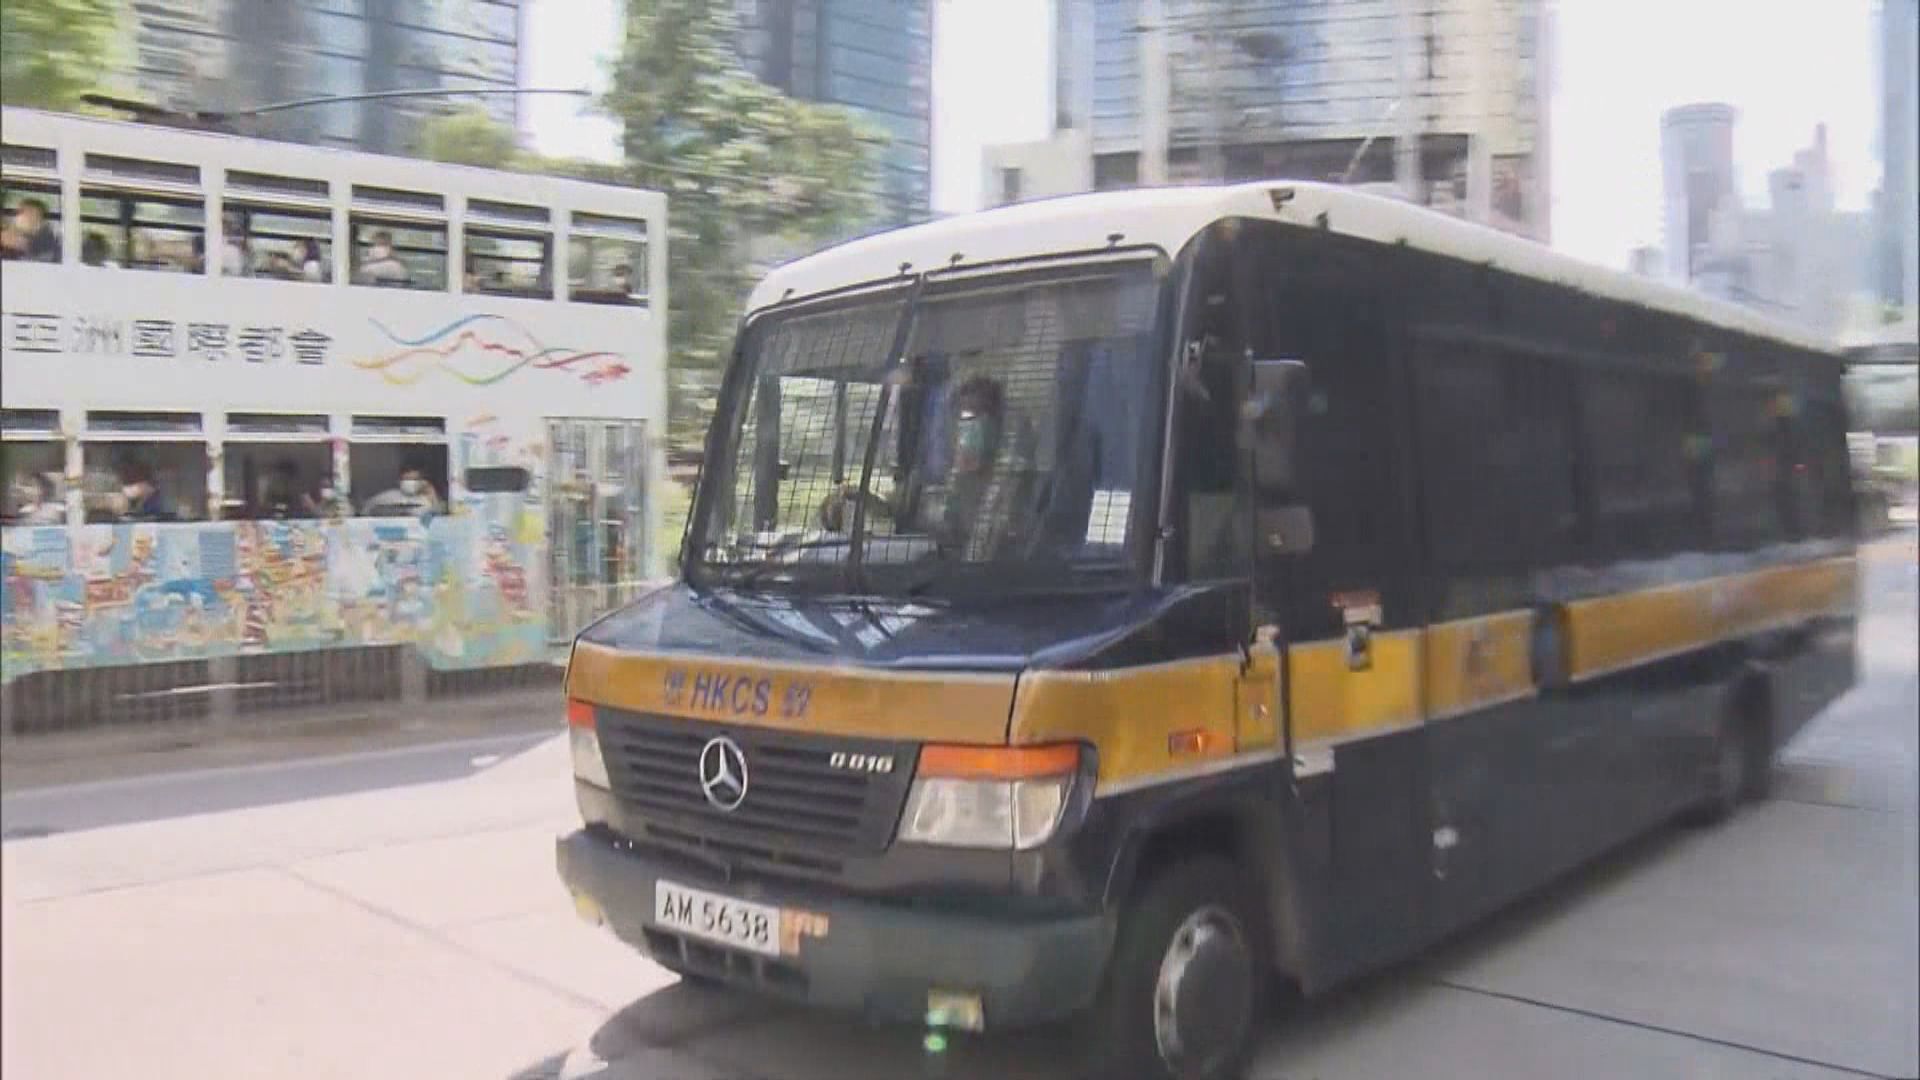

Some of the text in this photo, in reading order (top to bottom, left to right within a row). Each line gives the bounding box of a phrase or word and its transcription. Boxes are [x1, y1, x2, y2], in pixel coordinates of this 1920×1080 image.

[690, 671, 771, 717] HKCS
[663, 892, 770, 944] AM 5638
